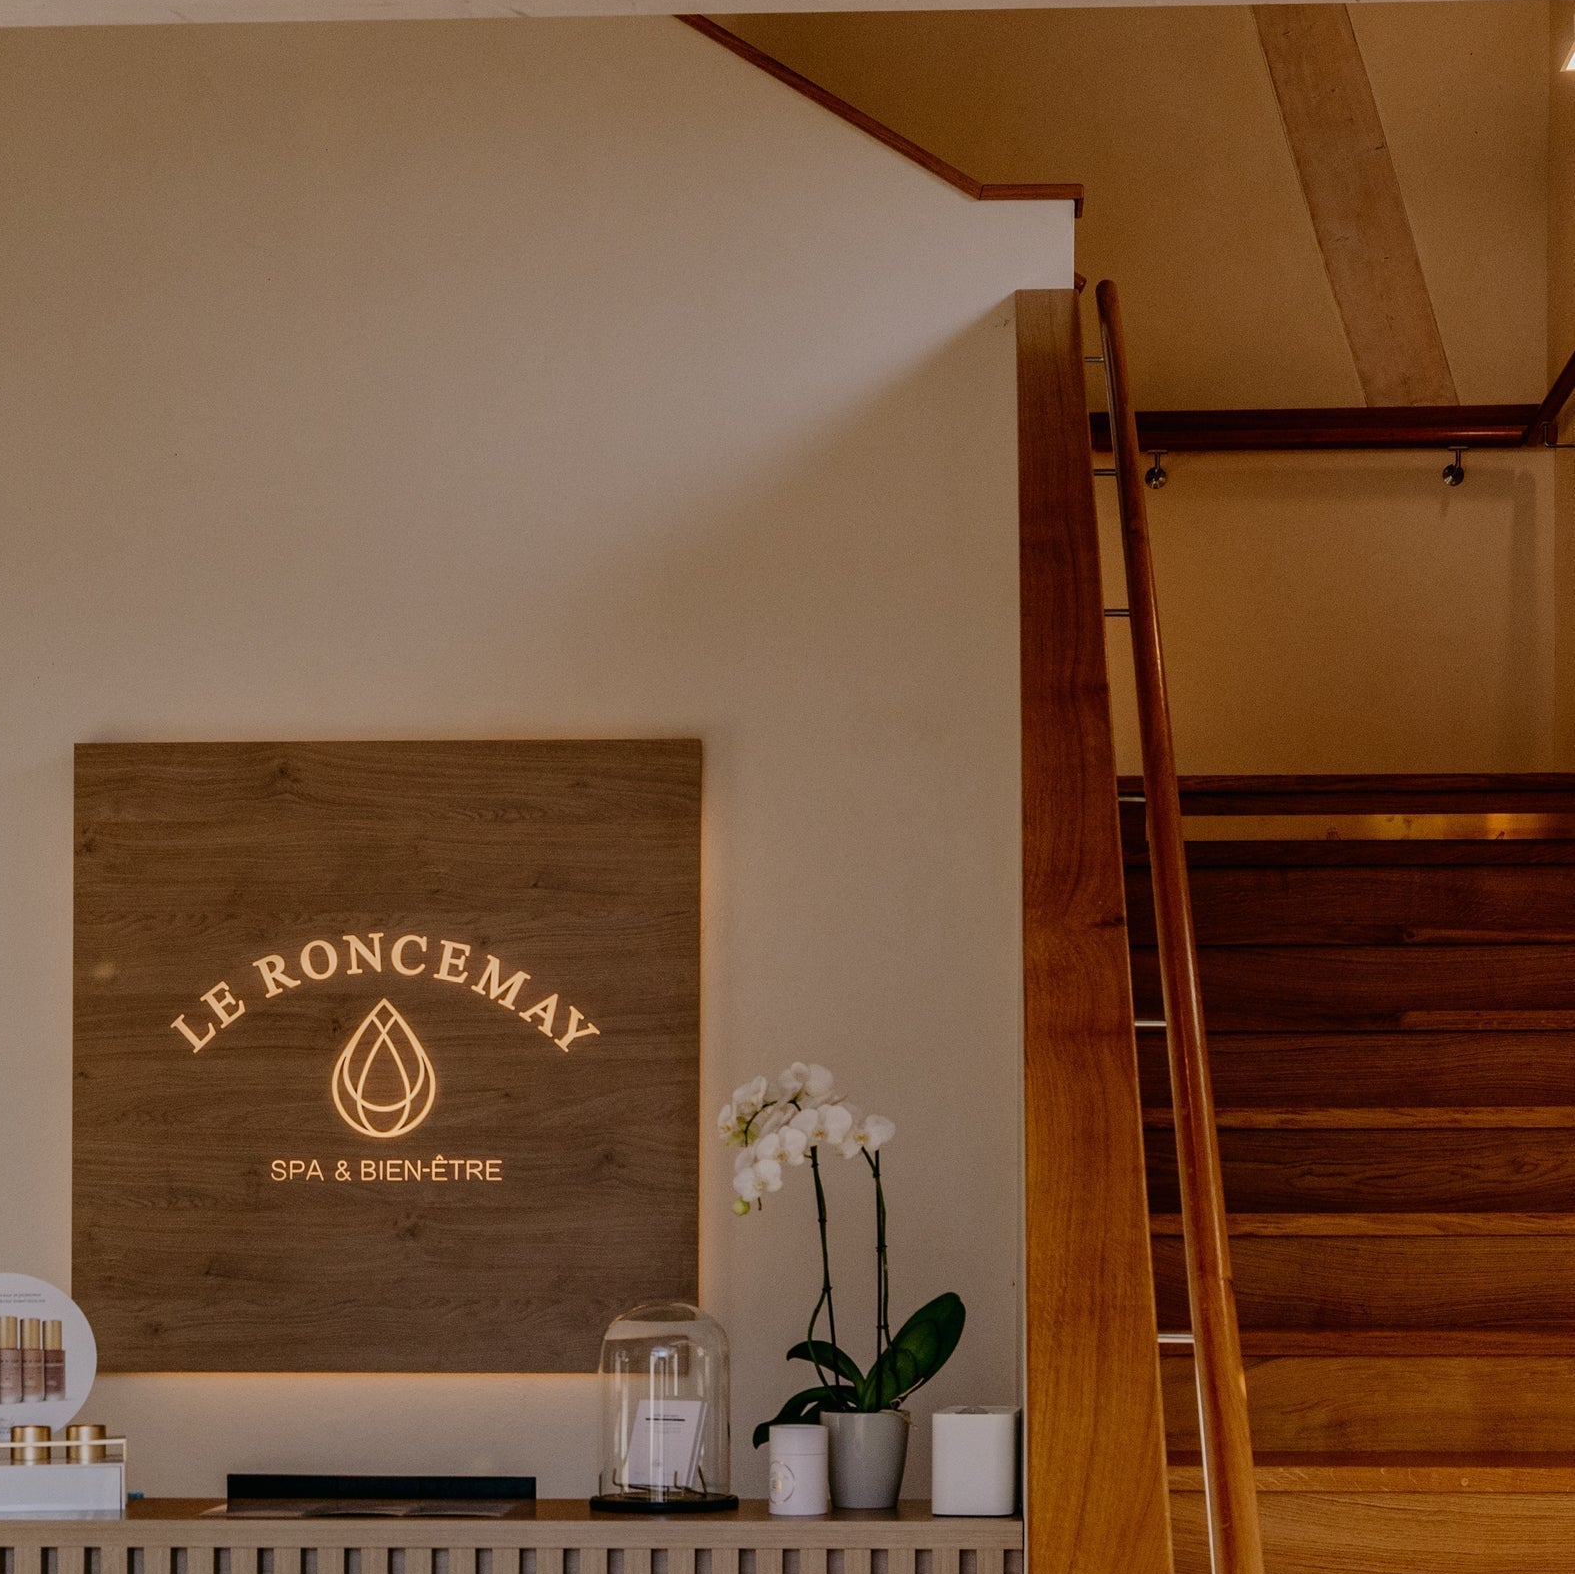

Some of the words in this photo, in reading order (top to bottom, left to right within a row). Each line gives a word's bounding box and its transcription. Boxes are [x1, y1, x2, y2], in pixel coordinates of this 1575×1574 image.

[170, 980, 246, 1054] LE
[251, 932, 601, 1053] RONCEMAY
[271, 1159, 324, 1182] SPA
[334, 1159, 352, 1182] &
[360, 1153, 503, 1182] BIEN-ÊTRE
